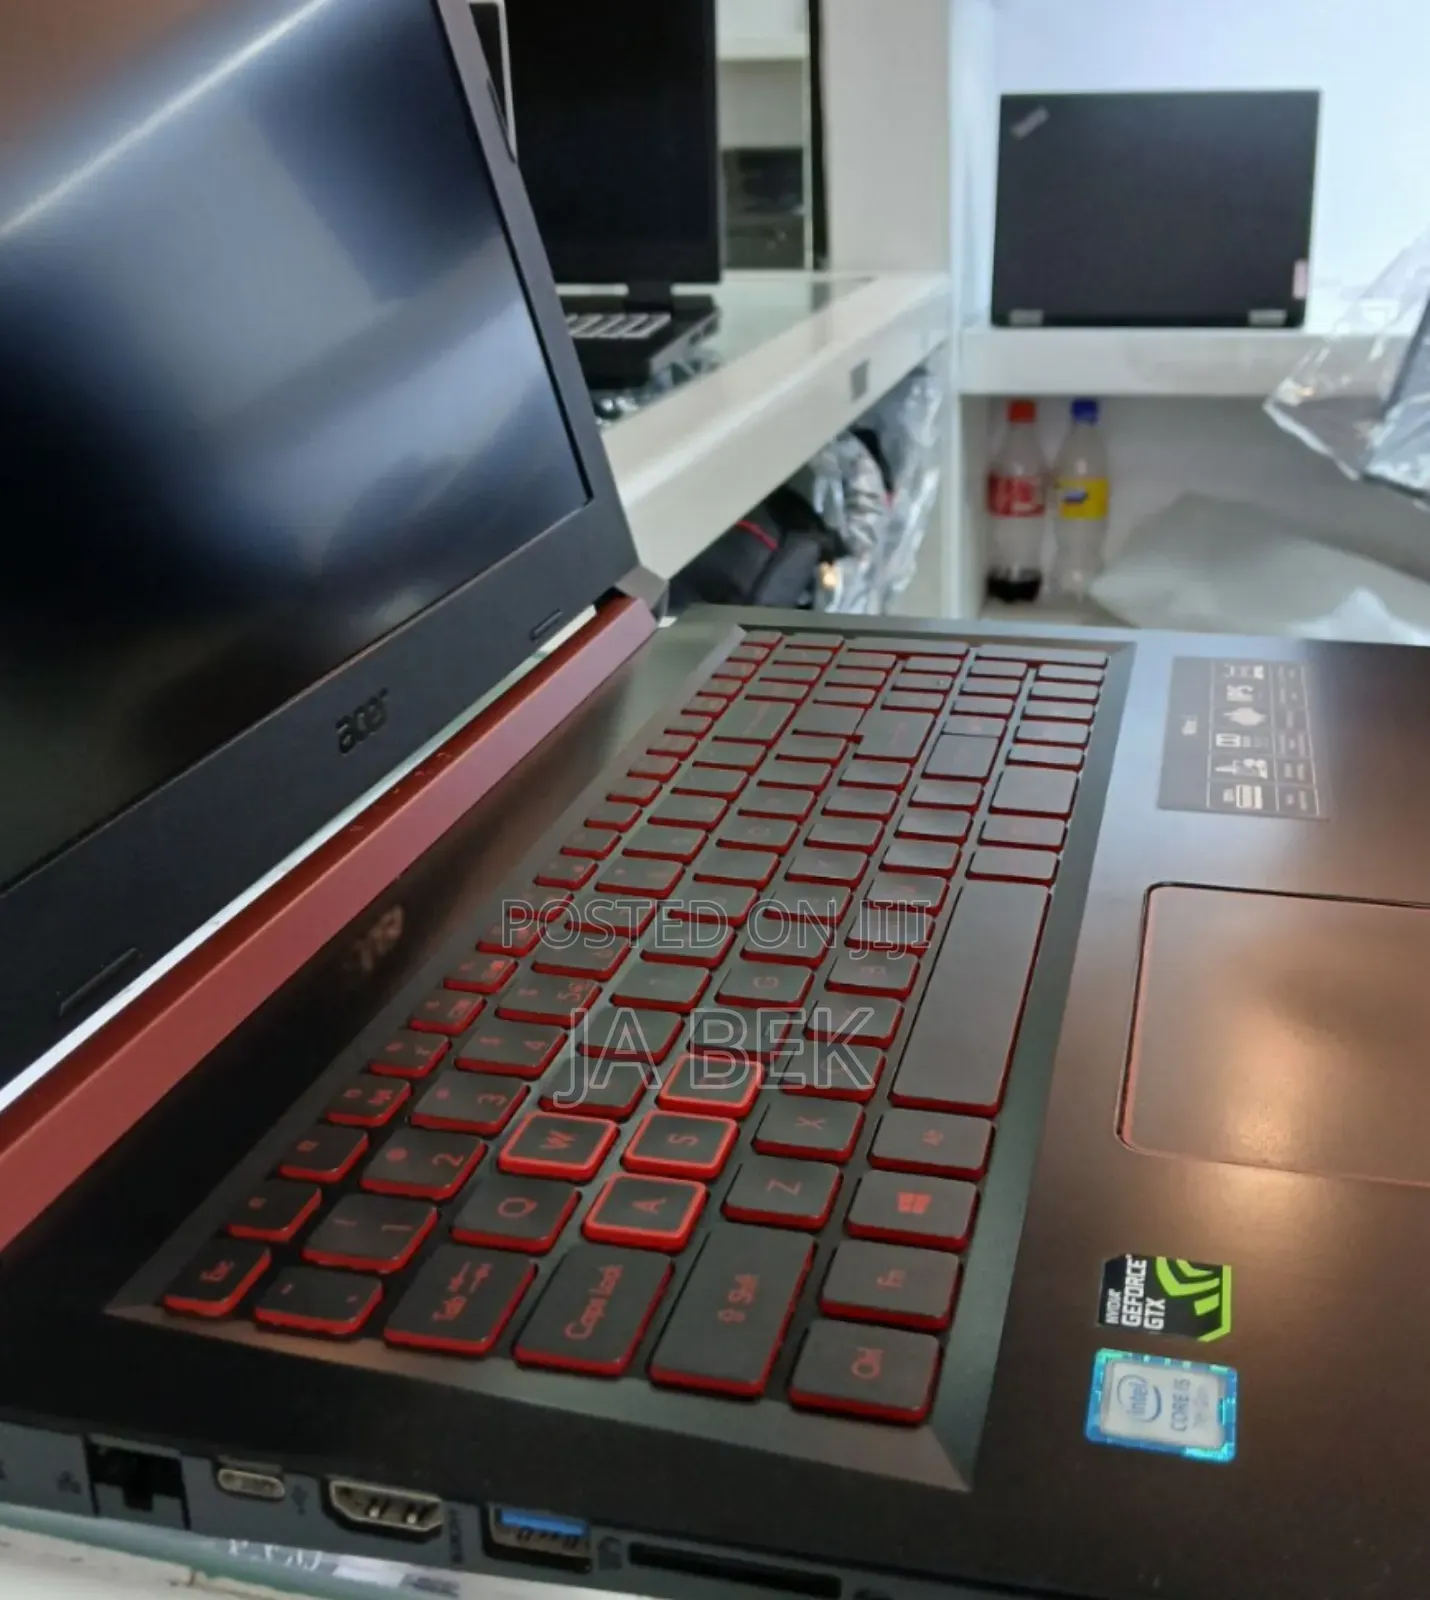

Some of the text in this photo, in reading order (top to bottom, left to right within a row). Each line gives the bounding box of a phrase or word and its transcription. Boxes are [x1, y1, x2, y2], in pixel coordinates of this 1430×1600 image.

[335, 687, 389, 754] acer
[476, 1092, 508, 1107] 3
[796, 1115, 826, 1131] X
[540, 1129, 577, 1151] W
[667, 1132, 699, 1147] S
[431, 1152, 465, 1169] 2
[766, 1178, 803, 1197] Z
[631, 1196, 668, 1215] A
[1121, 1256, 1148, 1327] GEFORCE
[1142, 1296, 1166, 1330] GTX
[1126, 1380, 1149, 1417] intel
[1170, 1393, 1190, 1432] CORE
